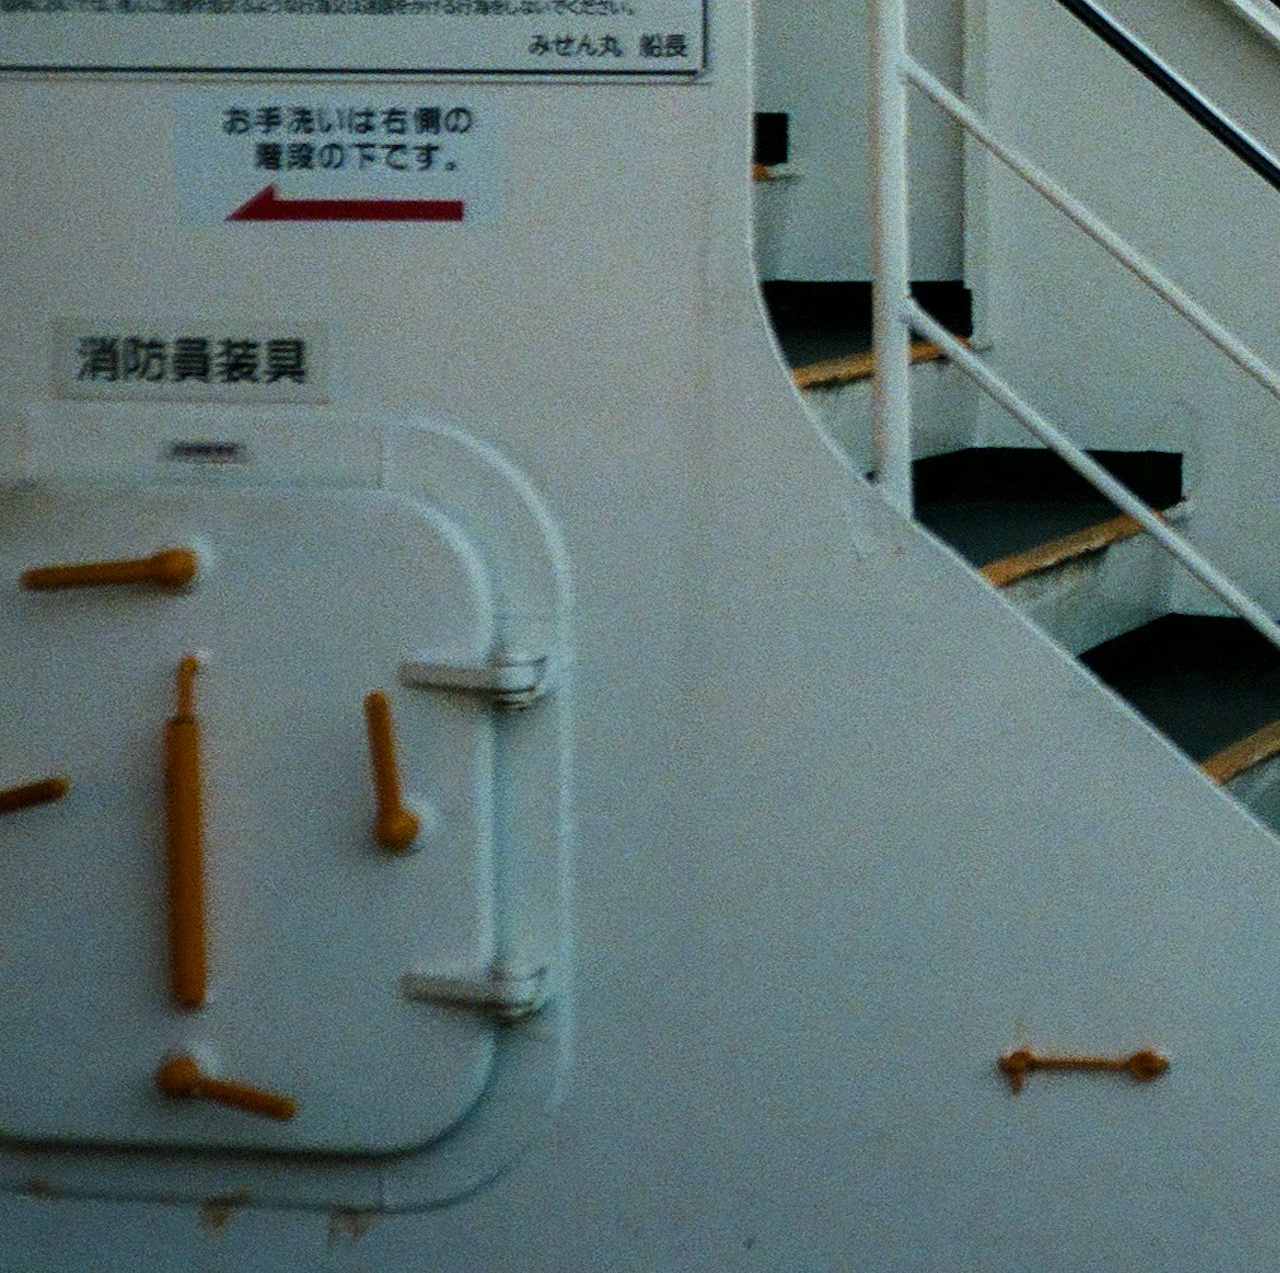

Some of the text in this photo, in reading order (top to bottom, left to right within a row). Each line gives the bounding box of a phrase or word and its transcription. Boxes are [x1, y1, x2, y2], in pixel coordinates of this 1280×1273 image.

[221, 105, 474, 135] お手洗いは右側の
